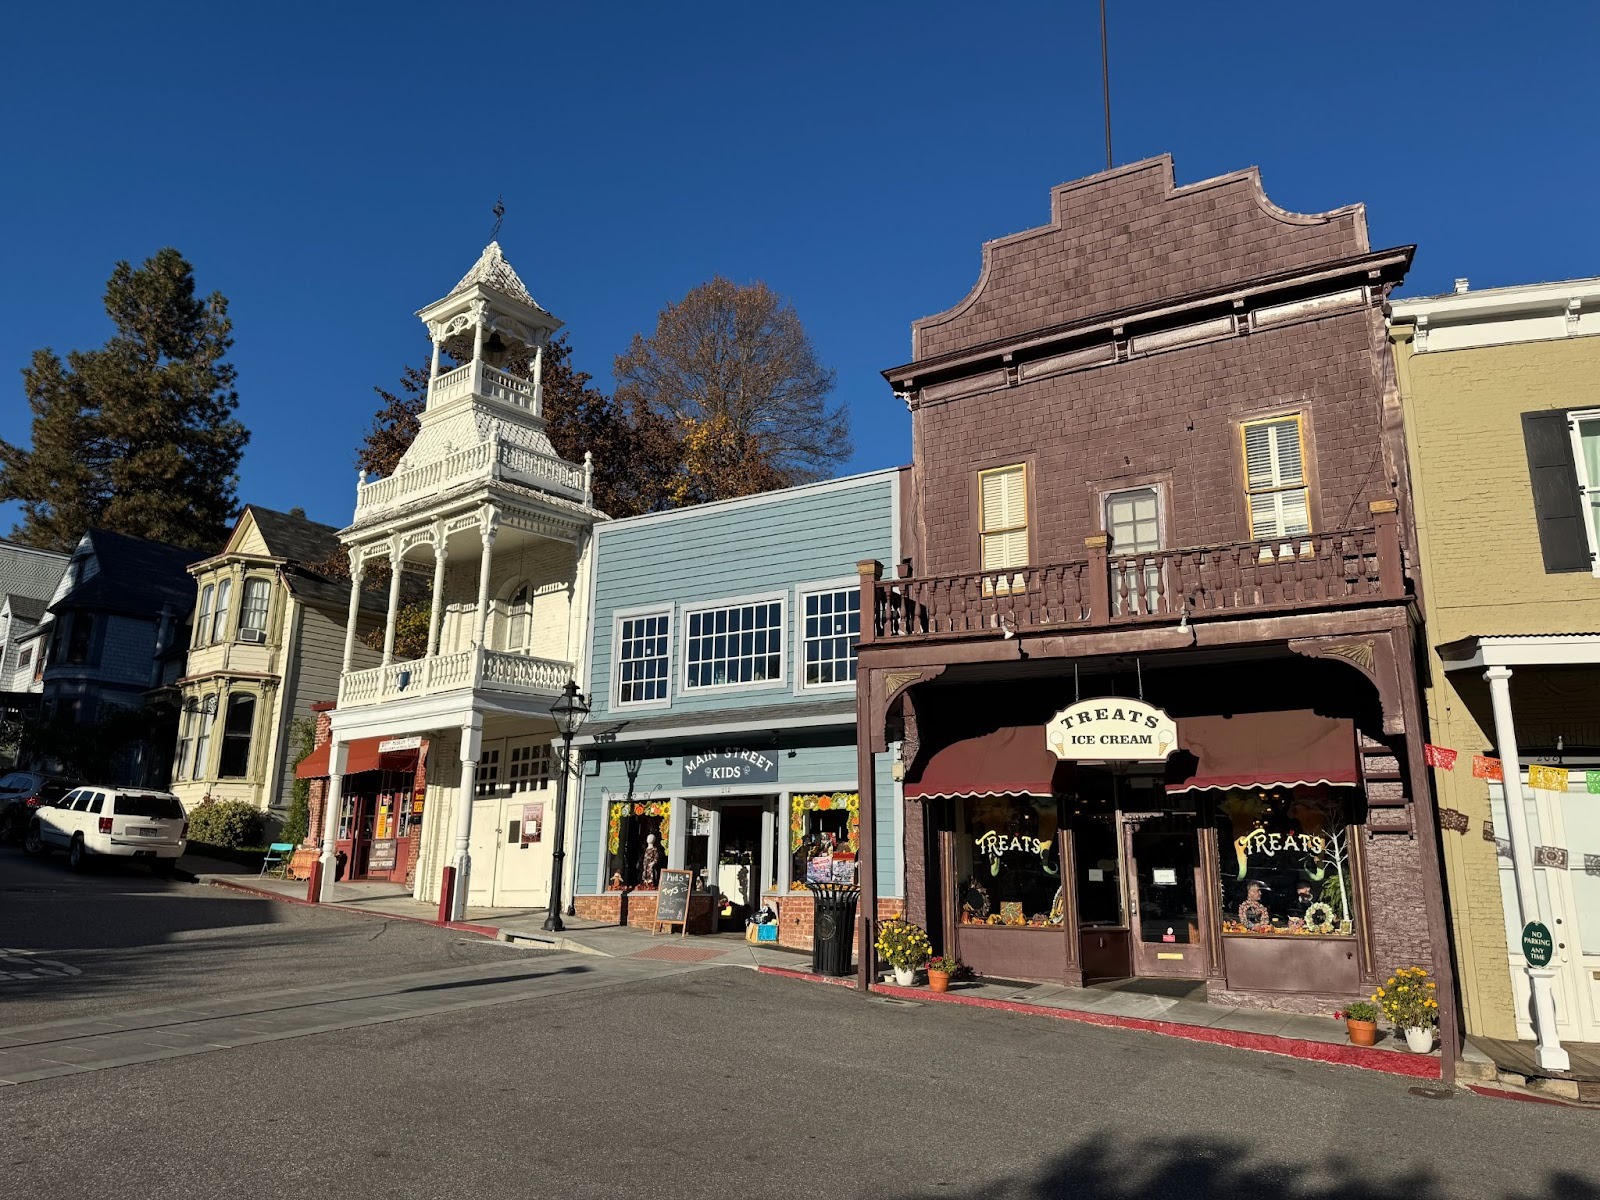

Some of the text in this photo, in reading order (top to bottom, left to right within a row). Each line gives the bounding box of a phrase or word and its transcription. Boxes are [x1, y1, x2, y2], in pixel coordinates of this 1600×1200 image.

[1060, 708, 1159, 730] TREATS
[1071, 734, 1153, 745] ICE CREAM
[684, 747, 774, 775] MAIN STREET
[712, 765, 741, 779] KIDS
[975, 829, 1041, 857] TREATS
[1239, 828, 1322, 857] TREATS
[1523, 936, 1551, 947] PARKING
[1531, 930, 1543, 939] NO
[1530, 953, 1546, 961] TIME
